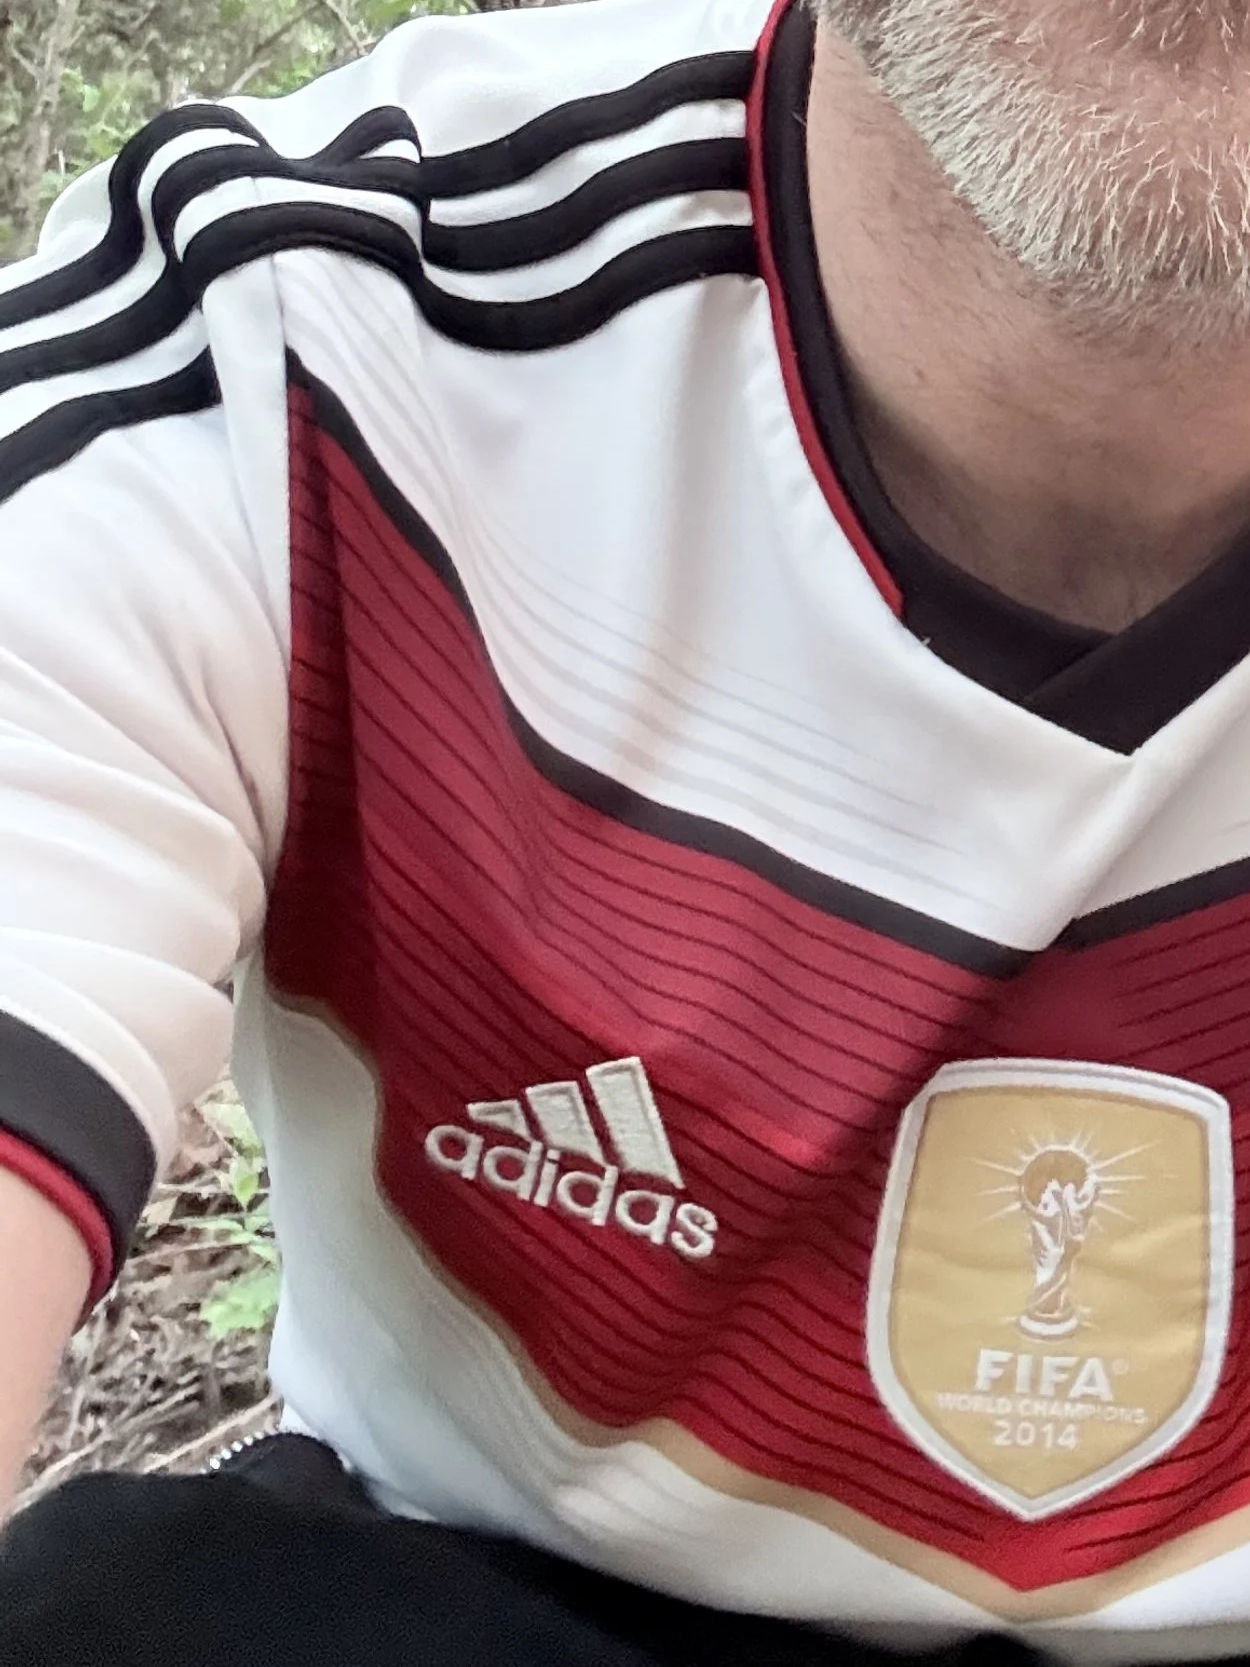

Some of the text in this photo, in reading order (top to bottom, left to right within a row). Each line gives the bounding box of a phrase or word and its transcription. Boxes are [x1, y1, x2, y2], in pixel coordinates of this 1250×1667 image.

[424, 1124, 719, 1259] adidas
[974, 1347, 1115, 1403] FIFA
[936, 1392, 1149, 1425] WORLD CHAMPIONS
[993, 1418, 1081, 1452] 2014
